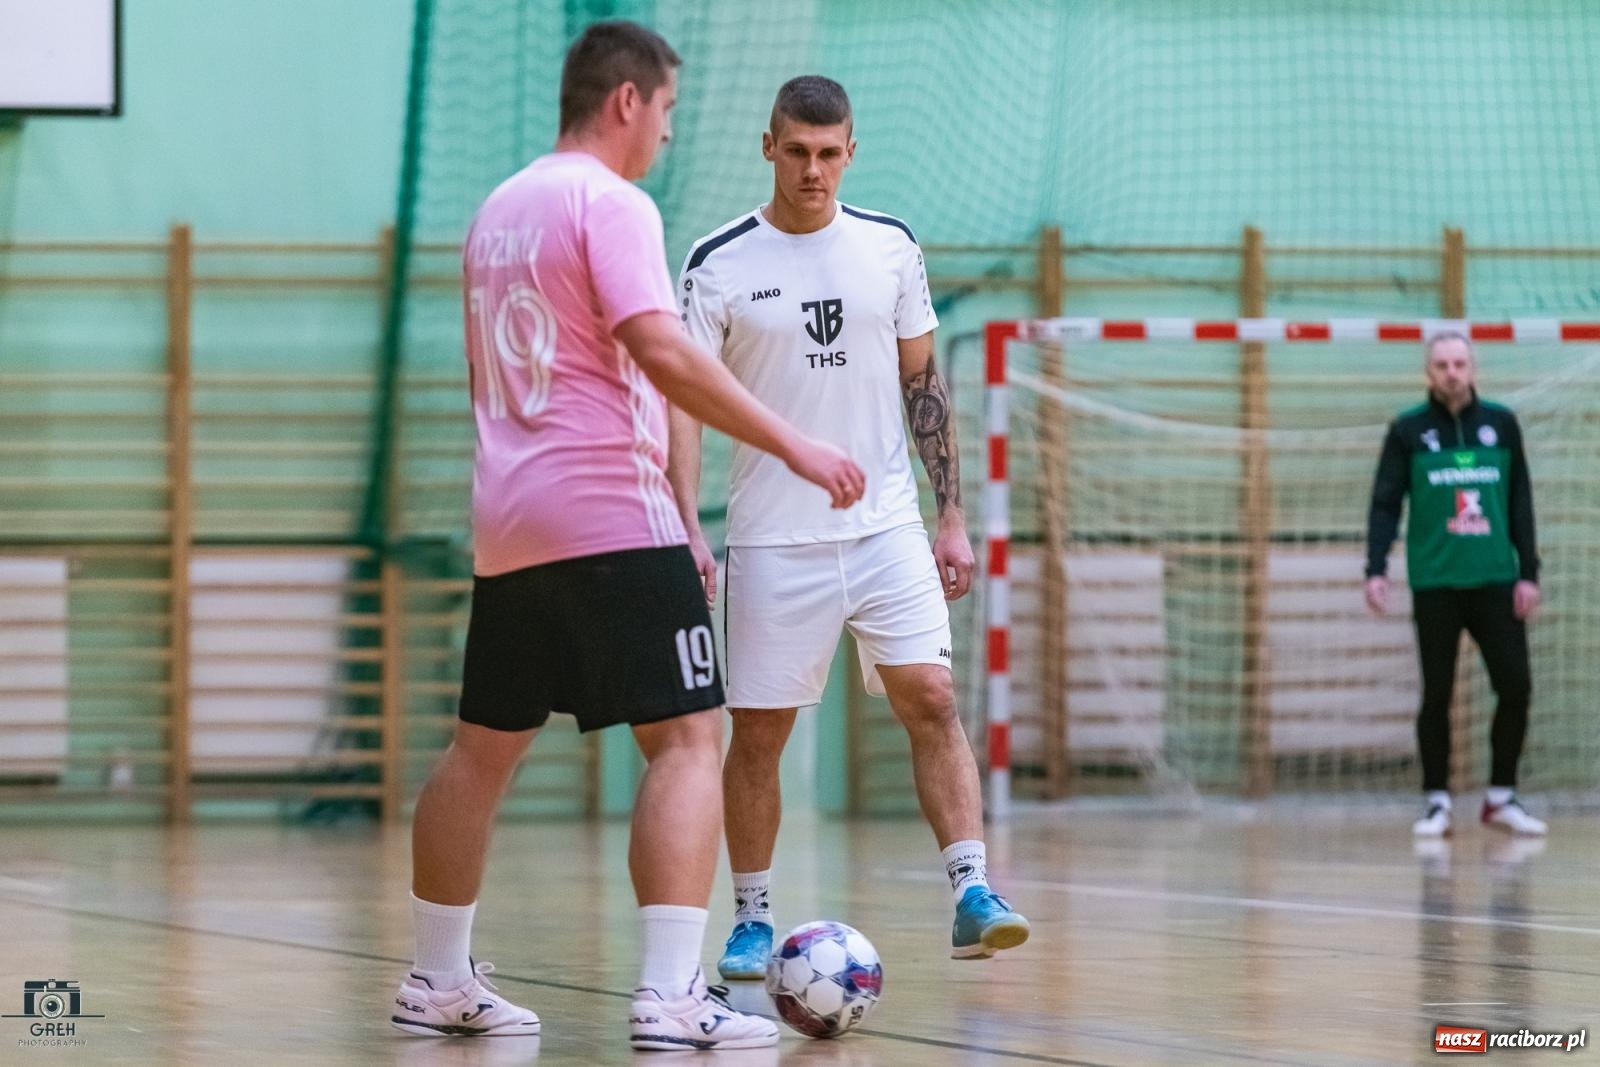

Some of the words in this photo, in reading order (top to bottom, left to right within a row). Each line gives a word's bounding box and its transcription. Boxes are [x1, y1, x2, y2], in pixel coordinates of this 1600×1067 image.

[751, 288, 781, 302] JAKO
[801, 298, 844, 347] JB
[470, 282, 557, 420] 19
[805, 351, 847, 369] THS
[675, 625, 714, 690] 19
